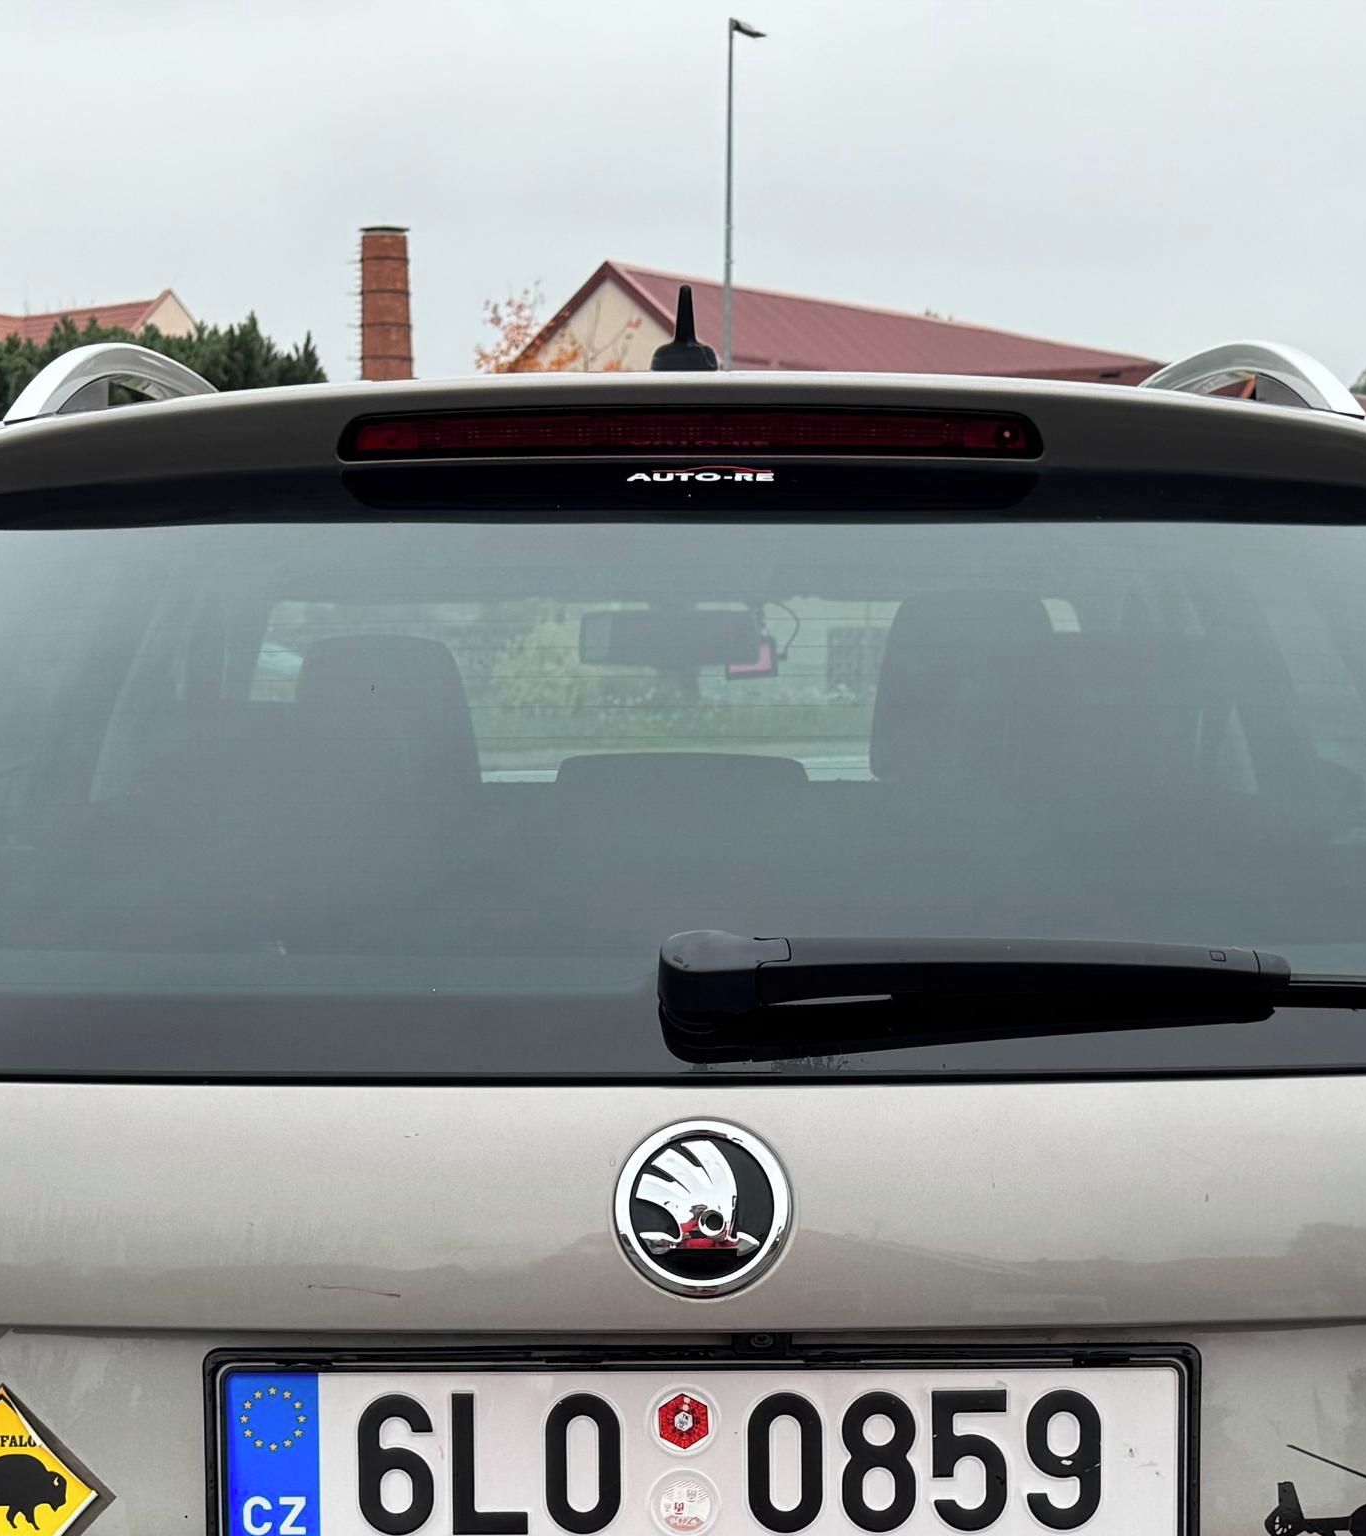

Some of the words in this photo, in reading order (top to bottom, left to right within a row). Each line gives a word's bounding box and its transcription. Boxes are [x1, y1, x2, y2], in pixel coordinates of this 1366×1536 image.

[627, 472, 774, 482] AUTO-RE
[358, 1393, 621, 1536] 6L0
[747, 1389, 1101, 1534] 0859
[242, 1496, 307, 1536] CZ
